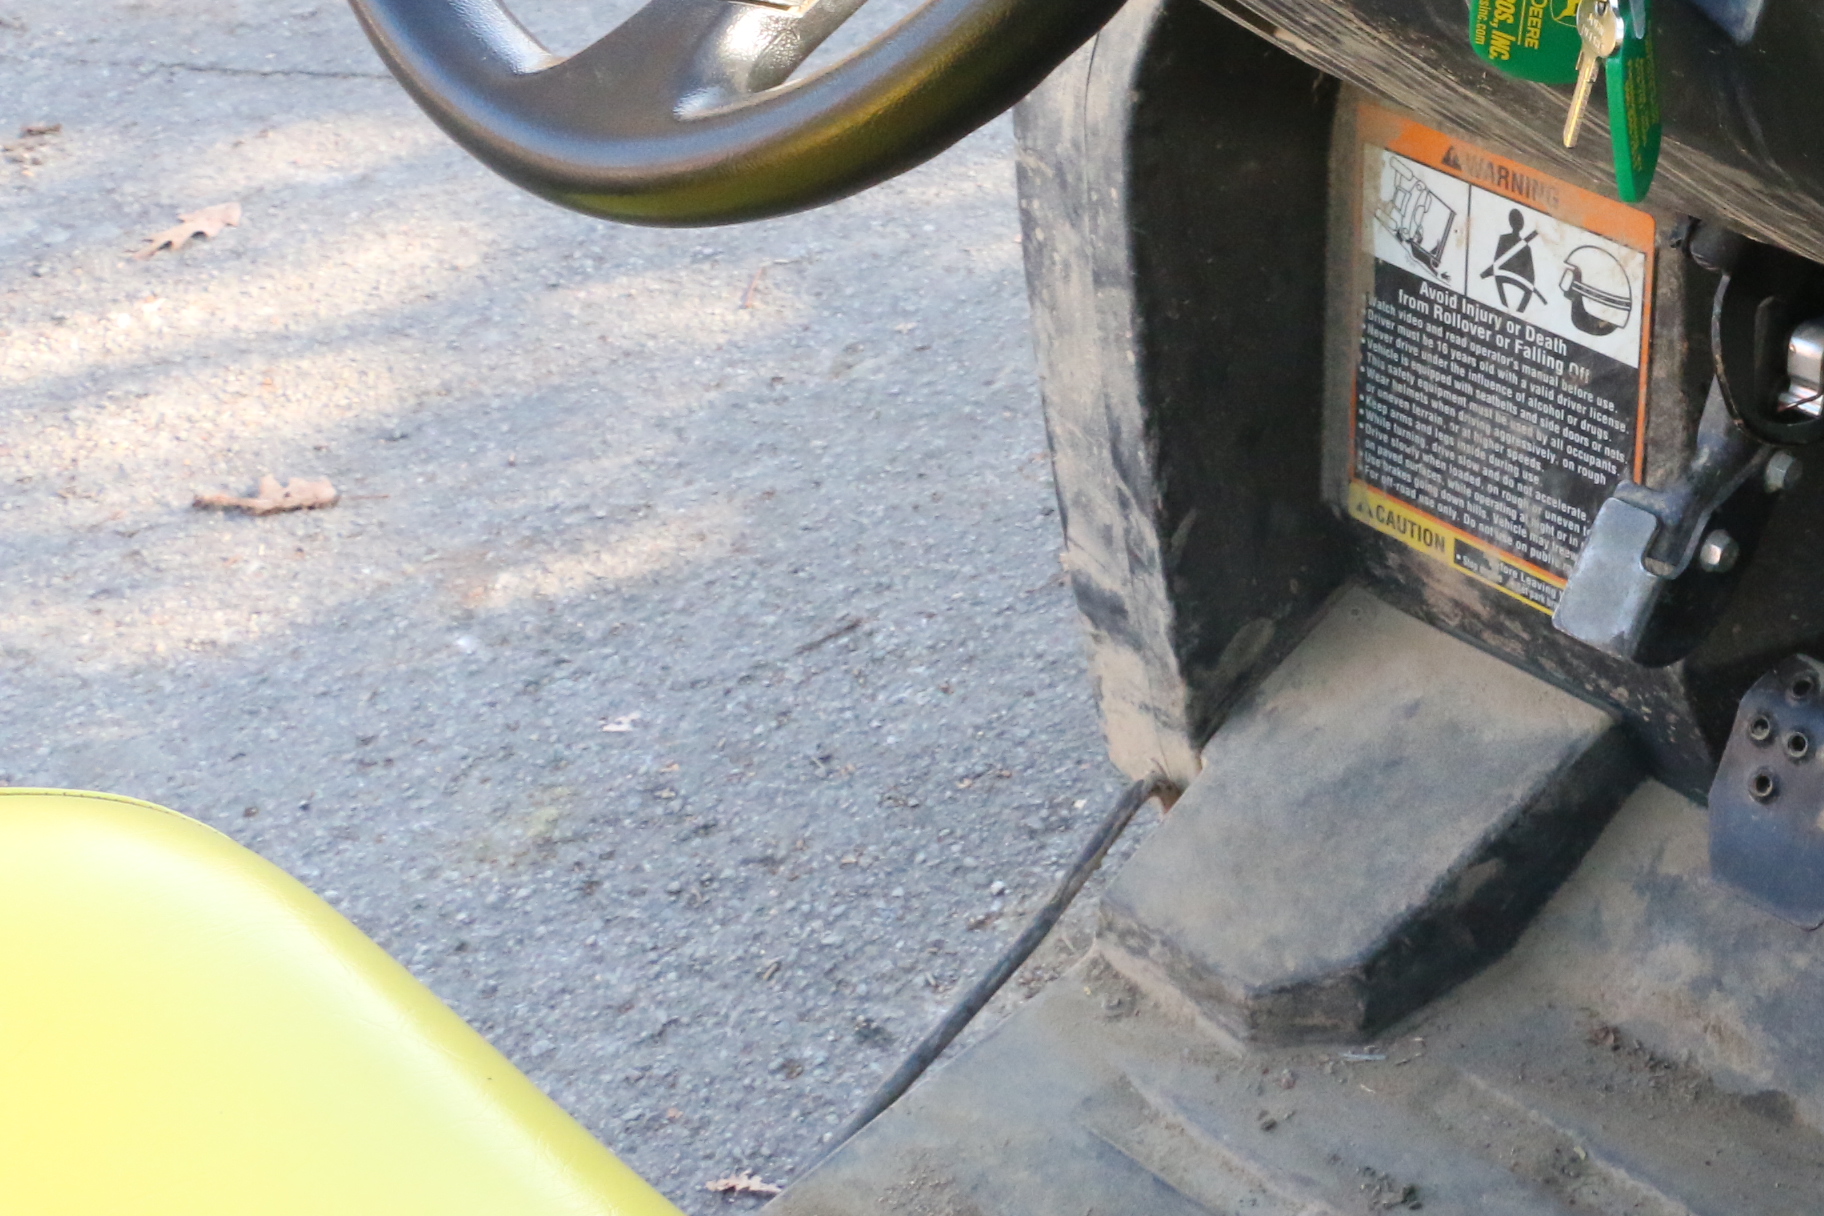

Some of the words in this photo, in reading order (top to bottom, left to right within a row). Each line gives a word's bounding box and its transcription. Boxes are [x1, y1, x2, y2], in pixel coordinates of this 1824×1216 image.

[1369, 294, 1394, 314] Watch
[1399, 310, 1422, 327] video
[1426, 322, 1442, 335] and
[1446, 330, 1466, 346] read
[1470, 341, 1518, 369] operator's
[1522, 364, 1557, 386] manual
[1562, 379, 1592, 401] before
[1597, 397, 1617, 412] use.
[1398, 288, 1428, 314] from
[1433, 303, 1491, 341] Rollover
[1496, 333, 1509, 349] or
[1514, 338, 1563, 376] Falling
[1569, 361, 1589, 384] Off
[1419, 280, 1457, 309] Avoid
[1462, 298, 1501, 331] Injury
[1506, 320, 1520, 336] or
[1526, 325, 1566, 356] Death
[1366, 337, 1398, 360] Vehicle
[1401, 353, 1408, 365] is
[1411, 360, 1451, 384] equipped
[1454, 379, 1472, 394] with
[1476, 389, 1516, 414] seatbelts
[1520, 409, 1536, 423] and
[1540, 418, 1559, 433] side
[1563, 425, 1588, 446] doors
[1592, 441, 1600, 452] or
[1605, 447, 1626, 464] nets.
[1367, 309, 1394, 330] Driver
[1397, 325, 1419, 341] must
[1422, 333, 1433, 347] be
[1436, 340, 1447, 353] 16
[1450, 348, 1476, 366] years
[1479, 361, 1494, 374] old
[1498, 369, 1517, 384] with
[1530, 383, 1553, 400] valid
[1557, 393, 1585, 415] driver
[1590, 407, 1628, 433] license.
[1367, 323, 1392, 343] Never
[1396, 336, 1418, 355] drive
[1422, 350, 1447, 368] under
[1451, 360, 1464, 376] the
[1468, 368, 1511, 397] influence
[1516, 392, 1524, 402] of
[1528, 397, 1563, 420] alcohol
[1567, 415, 1576, 426] or
[1581, 418, 1611, 441] drugs.
[1388, 364, 1414, 385] safety
[1417, 377, 1466, 406] equipment
[1551, 438, 1563, 450] all
[1566, 445, 1619, 476] occupants.
[1390, 408, 1412, 425] arms
[1415, 420, 1431, 434] and
[1436, 426, 1453, 444] legs
[1489, 451, 1518, 477] during
[1392, 378, 1427, 403] helmets
[1431, 398, 1455, 415] when
[1563, 458, 1573, 470] on
[1578, 465, 1605, 484] rough
[1507, 448, 1543, 472] speeds.
[1422, 452, 1445, 470] when
[1488, 482, 1498, 494] on
[1545, 509, 1579, 533] uneven
[1432, 439, 1454, 459] drive
[1458, 454, 1478, 470] slow
[1482, 465, 1499, 480] and
[1503, 472, 1513, 486] do
[1517, 481, 1532, 495] not
[1535, 490, 1588, 522] accelerate.
[1441, 486, 1463, 507] down
[1493, 511, 1526, 537] Vehicle
[1530, 531, 1548, 550] may
[1375, 504, 1446, 553] CAUTION
[1463, 511, 1474, 527] Do
[1516, 539, 1526, 552] on
[1557, 530, 1565, 541] or
